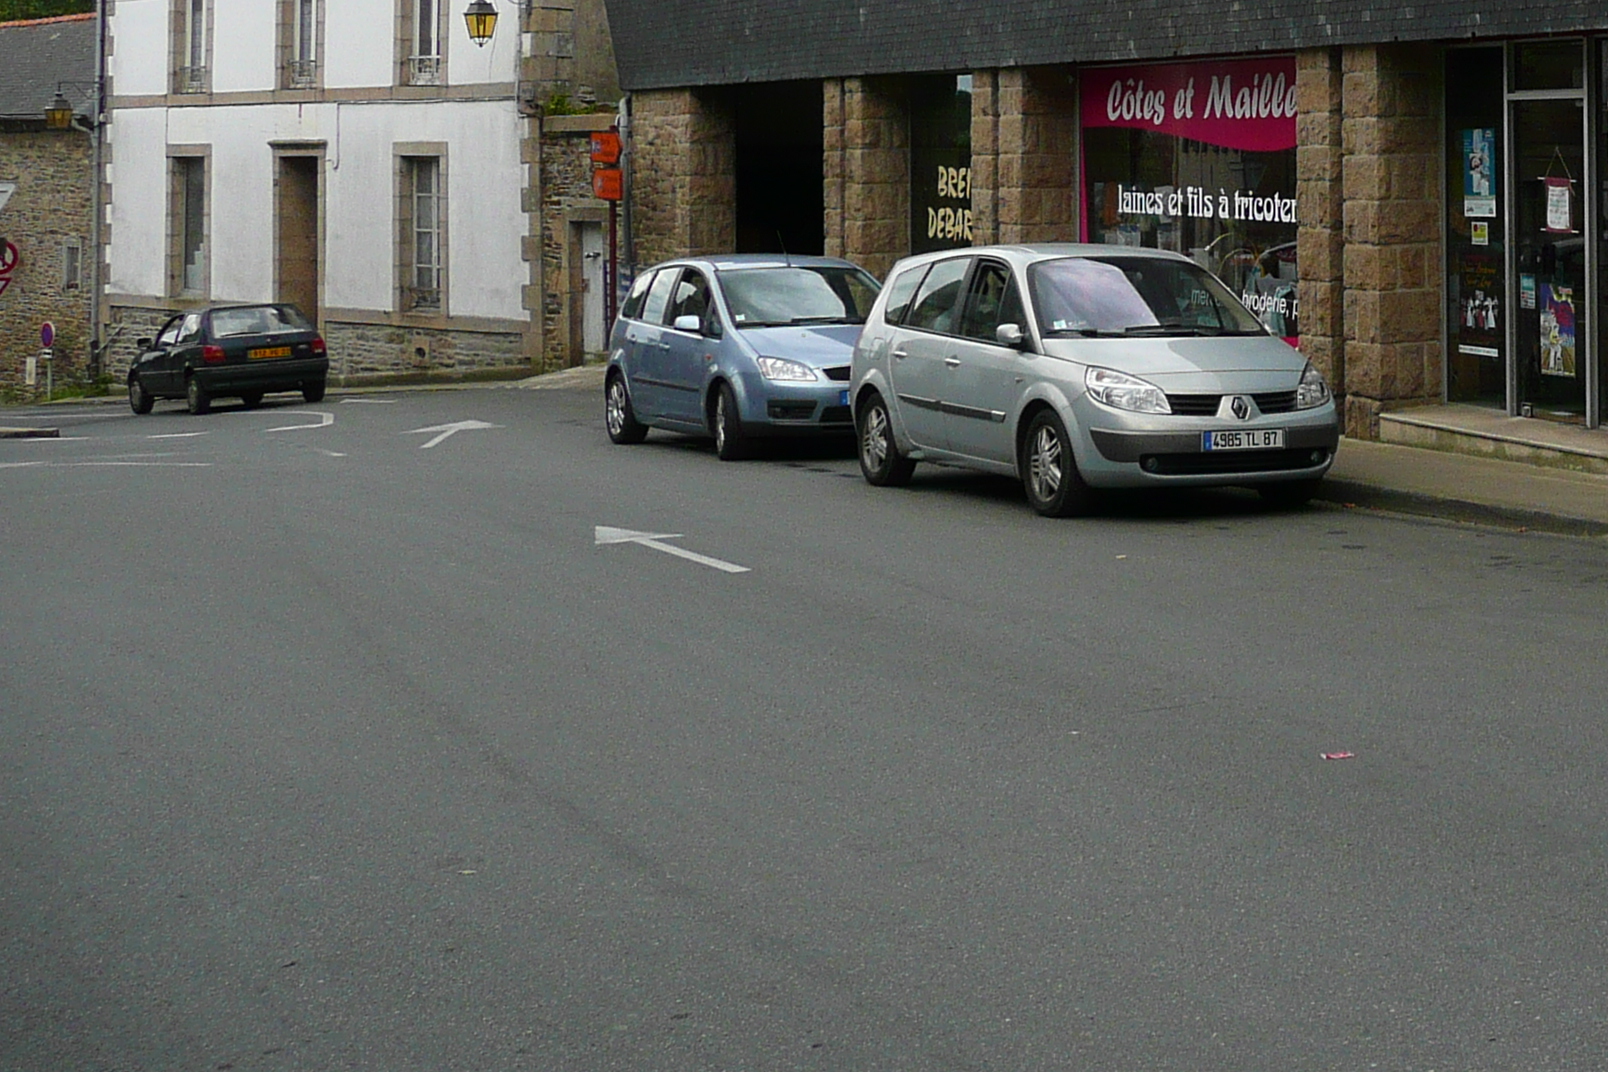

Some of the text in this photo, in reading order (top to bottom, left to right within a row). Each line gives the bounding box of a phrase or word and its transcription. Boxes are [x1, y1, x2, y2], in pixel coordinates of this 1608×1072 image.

[1107, 78, 1165, 125] Côtes
[1174, 77, 1194, 120] et
[1118, 184, 1164, 215] laines
[1168, 188, 1183, 216] et
[1187, 186, 1213, 218] fils
[1219, 188, 1229, 219] à
[928, 207, 972, 241] DEBAR
[1213, 431, 1277, 447] 4985 TL 87
